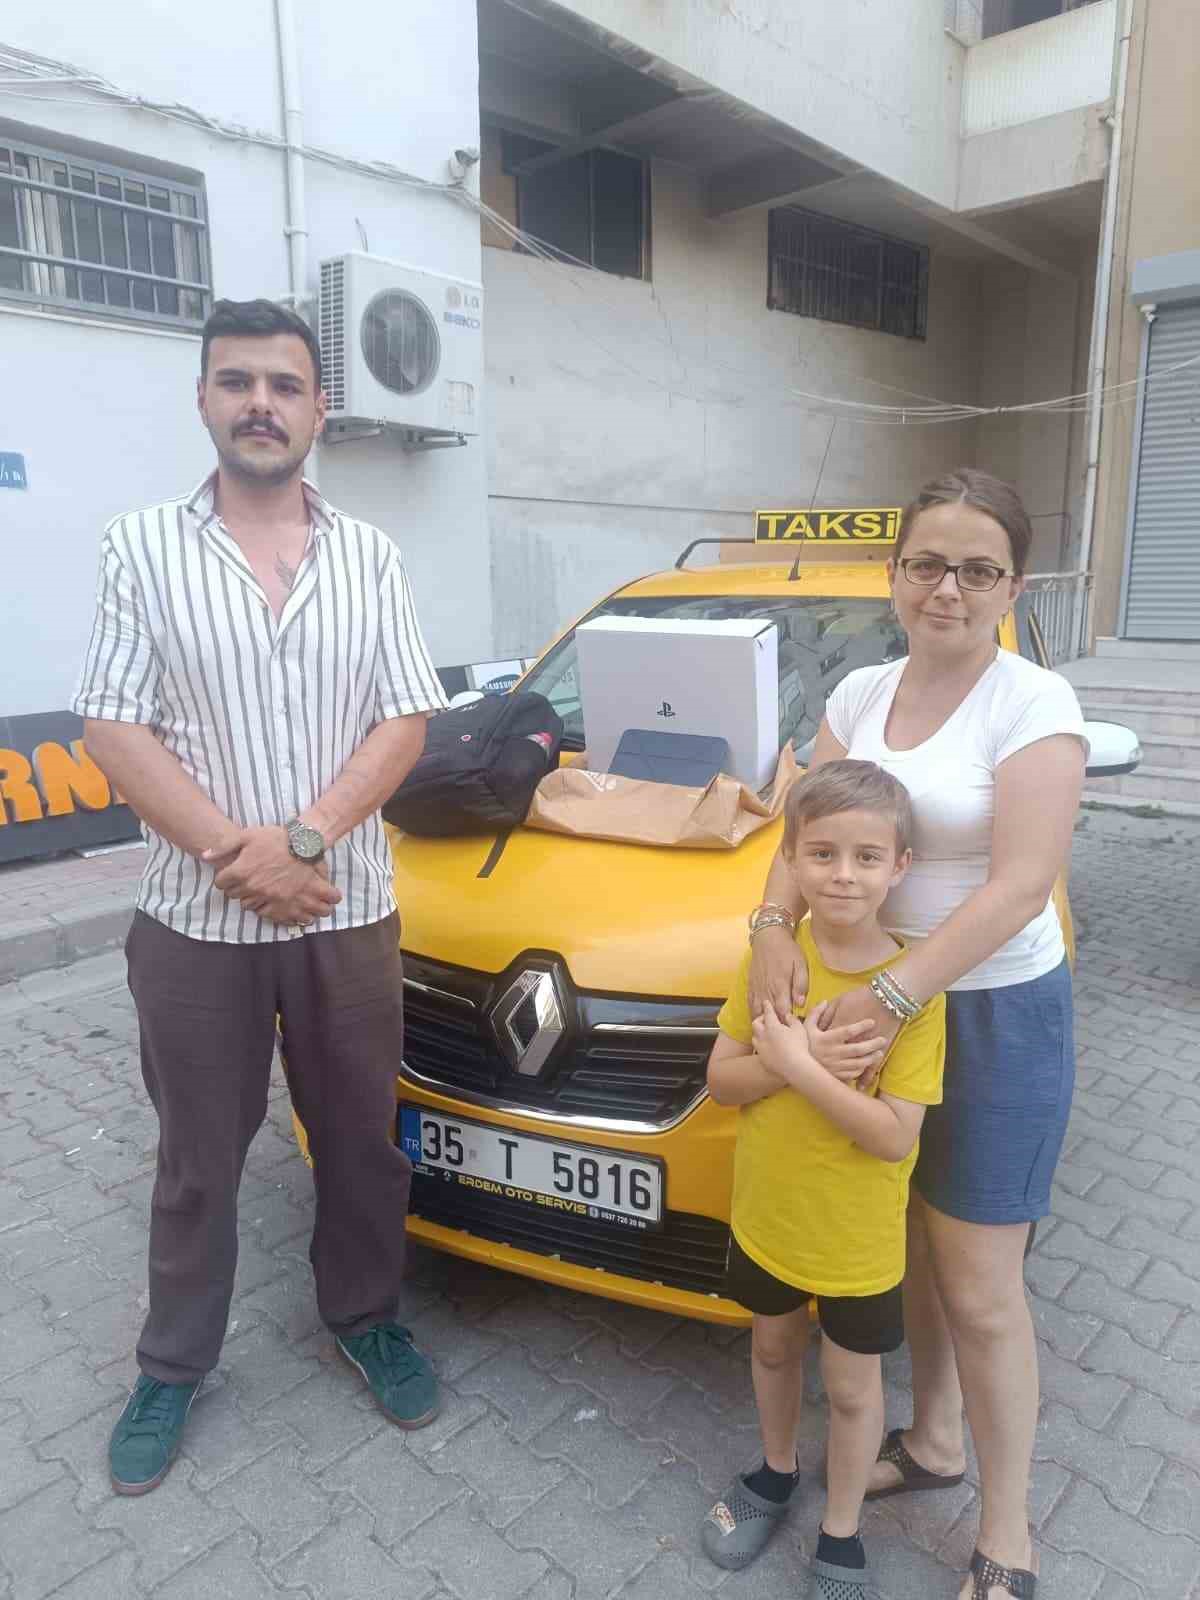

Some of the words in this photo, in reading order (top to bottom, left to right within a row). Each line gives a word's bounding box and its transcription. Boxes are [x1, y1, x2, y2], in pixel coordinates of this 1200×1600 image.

[405, 1137, 420, 1151] TR
[422, 1120, 464, 1166] 35
[498, 1138, 519, 1180] T
[552, 1151, 652, 1211] 5816
[458, 1175, 503, 1194] ERDEM
[505, 1186, 533, 1202] OTO
[535, 1194, 587, 1216] SERVIS
